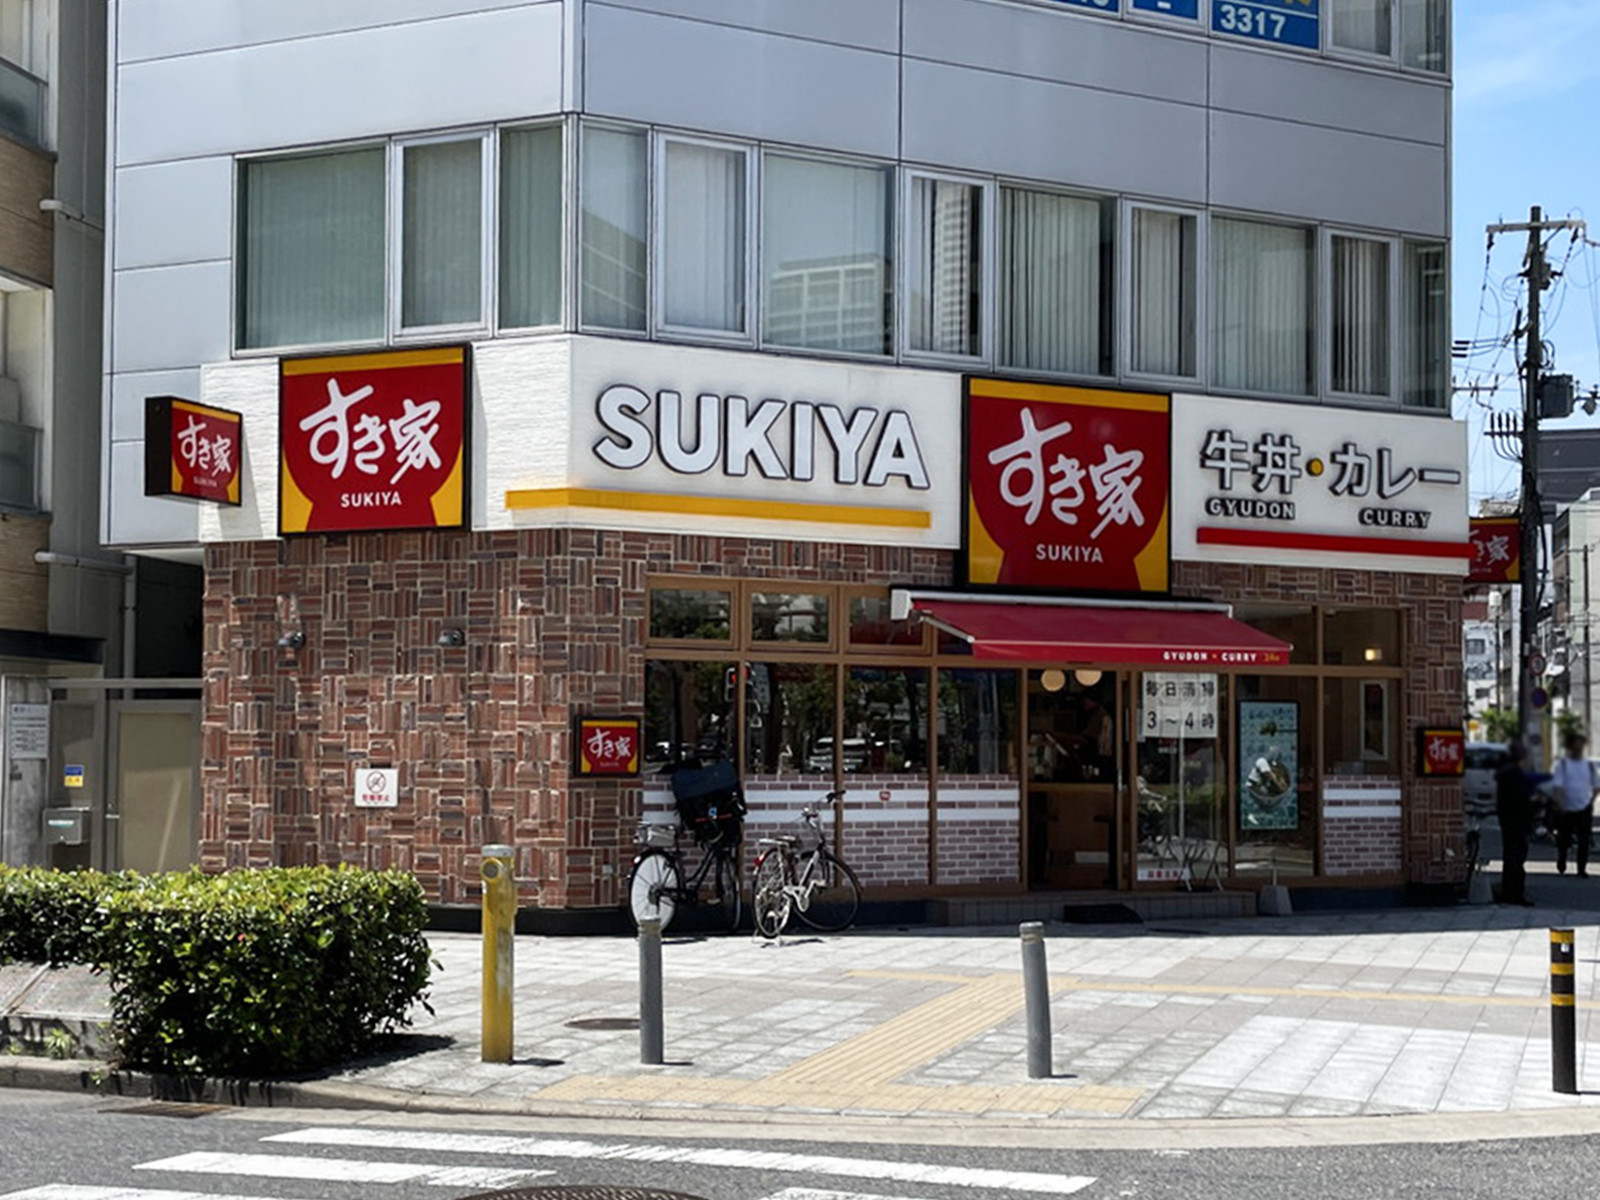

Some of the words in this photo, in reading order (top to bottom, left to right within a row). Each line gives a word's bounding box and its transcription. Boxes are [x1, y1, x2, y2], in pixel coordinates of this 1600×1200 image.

[1219, 4, 1286, 38] 3317
[177, 414, 232, 477] すき家
[298, 378, 442, 484] すき家
[592, 383, 931, 490] SUKIYA
[988, 406, 1145, 540] すき家
[1200, 429, 1461, 500] 牛丼・カレー
[340, 490, 403, 508] SUKIYA
[1205, 496, 1296, 520] GYUDON
[1358, 507, 1431, 529] CURRY
[1035, 543, 1104, 563] SUKIYA
[1163, 650, 1208, 661] GYUDON
[1221, 651, 1257, 662] CURRY
[587, 728, 632, 761] すき家
